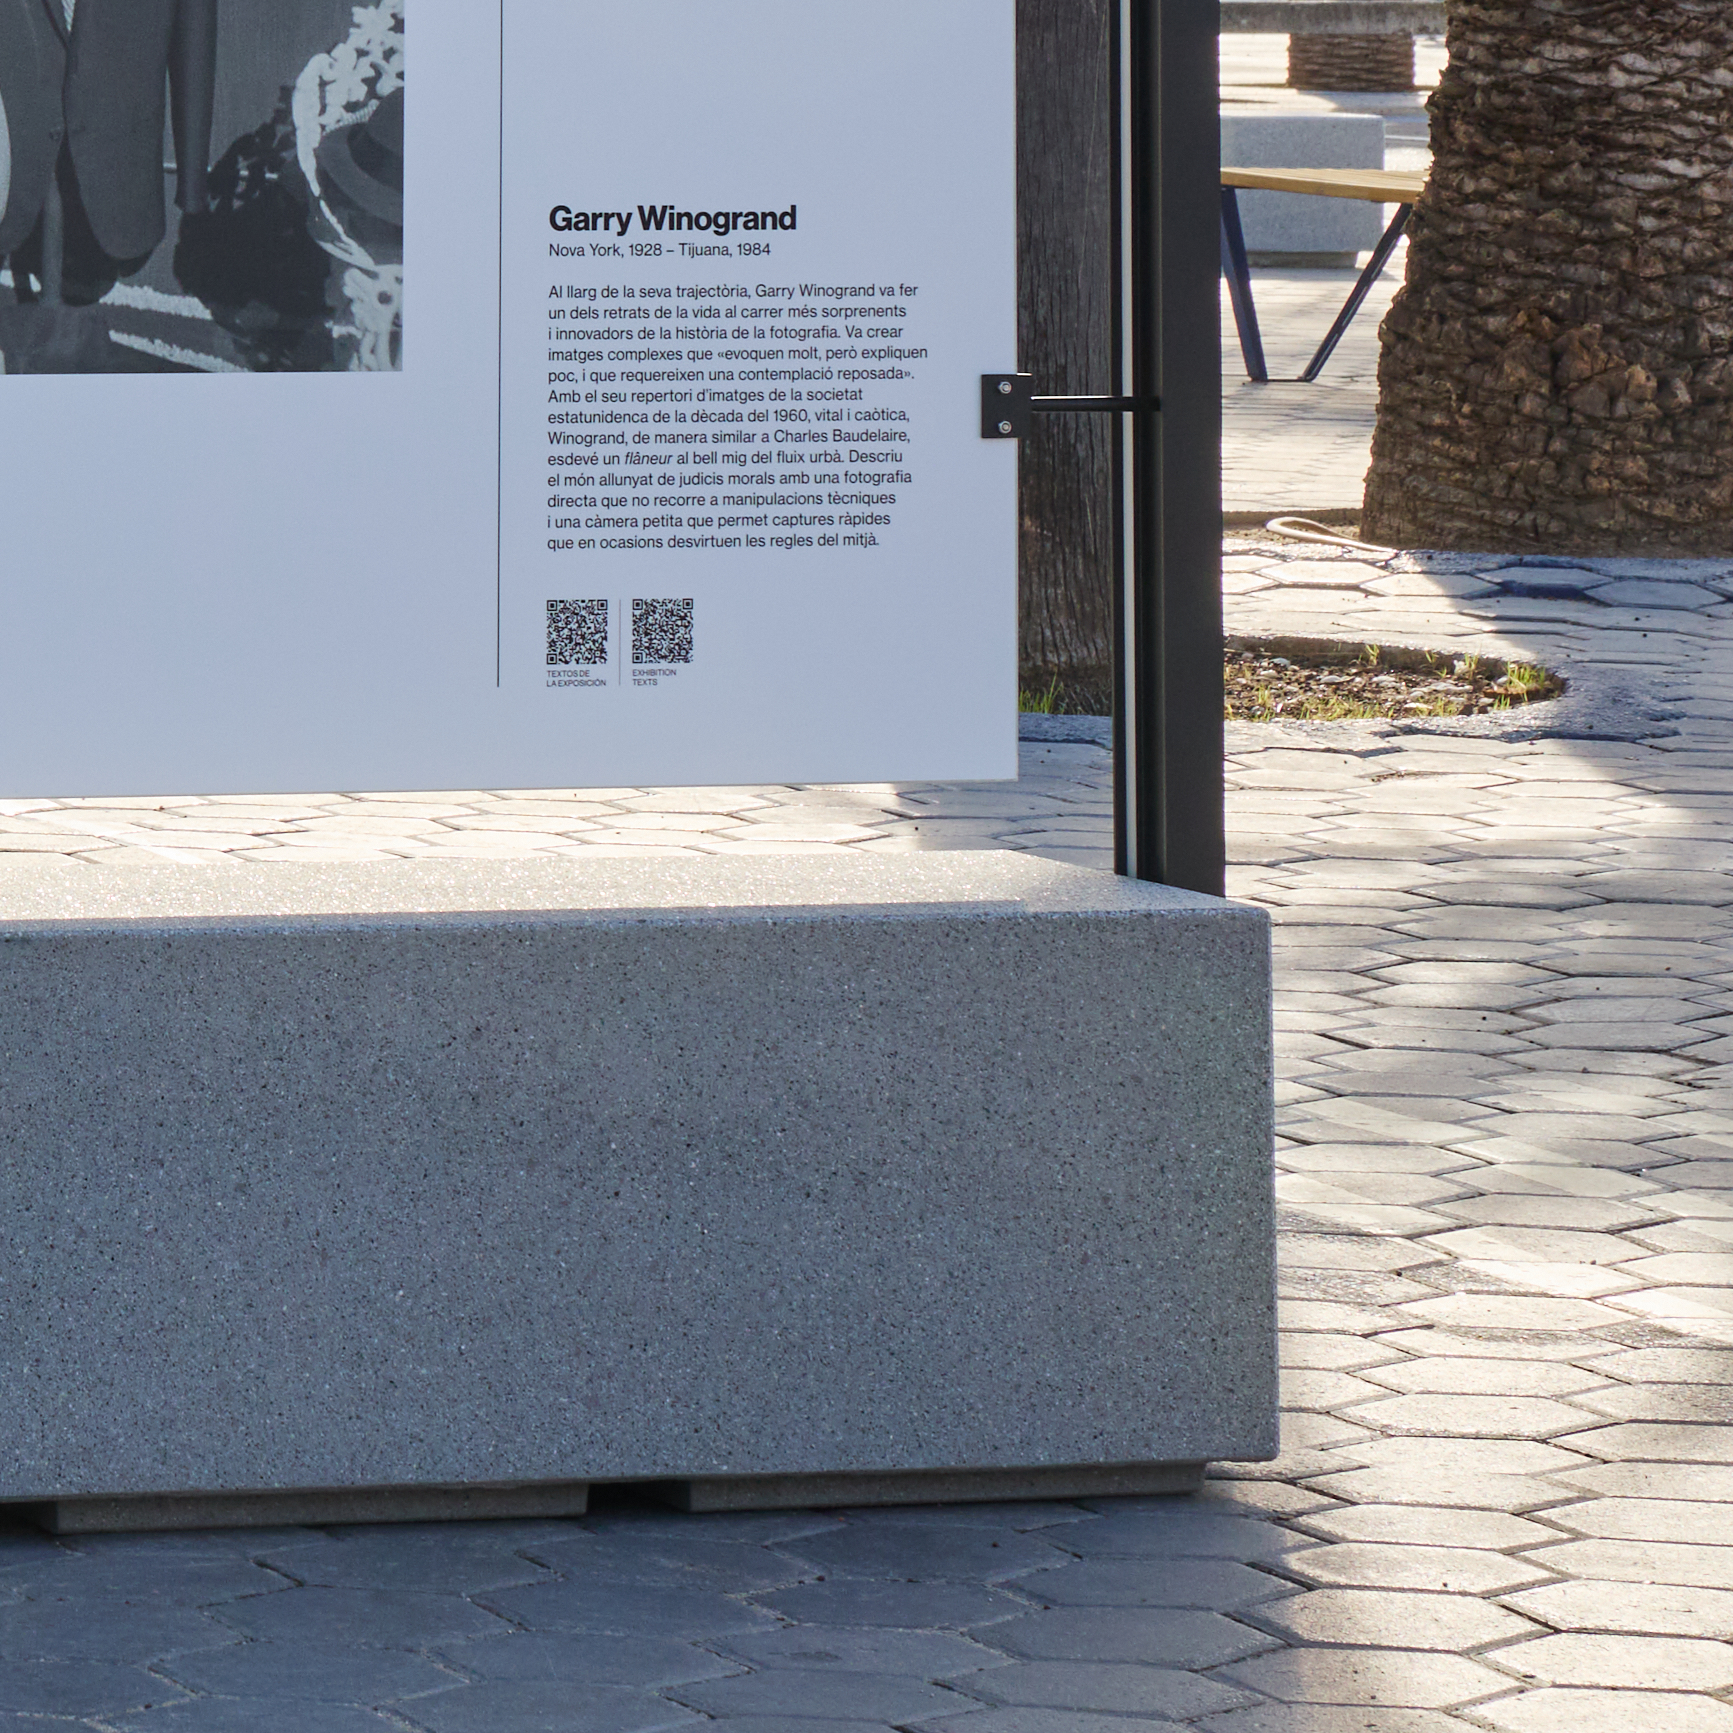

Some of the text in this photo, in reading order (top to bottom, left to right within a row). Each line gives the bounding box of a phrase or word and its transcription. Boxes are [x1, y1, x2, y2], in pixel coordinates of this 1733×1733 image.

[549, 205, 796, 236] Garry Winogrand
[549, 243, 771, 258] Nova York, 1928 Tijuana, 1984
[549, 283, 918, 301] Al llarg de la seva trajectòria, Garry Winogrand va fer
[549, 304, 906, 320] un dels retrats de la vida al carrer més sorprenents
[556, 325, 903, 341] innovadors de la història de la fotografia. Va crear
[549, 346, 927, 364] imatges complexes que «evoquen molt, però expliquen
[549, 366, 914, 385] poc, que requereixen una contemplació reposada».
[548, 388, 862, 405] Amb el seu repertori d'imatges de la societat
[548, 408, 909, 424] estatunidenca de la dècada del 1960, vital caòtica,
[548, 429, 910, 447] Winogrand, de manera similar Charles Baudelaire,
[548, 449, 902, 467] esdevé un flâneur al bell mig del fluix urbà. Descriu
[548, 470, 912, 489] el món allunyat de judicis morals amb una fotografia
[548, 491, 896, 509] directa que no recorre manipulacions tècniques
[555, 512, 890, 530] una càmera petita que permet captures ràpides
[547, 532, 879, 552] que en ocasions desvirtuen les regles del mitjà.
[547, 670, 578, 678] TEXTOS
[632, 678, 658, 686] TEXTS
